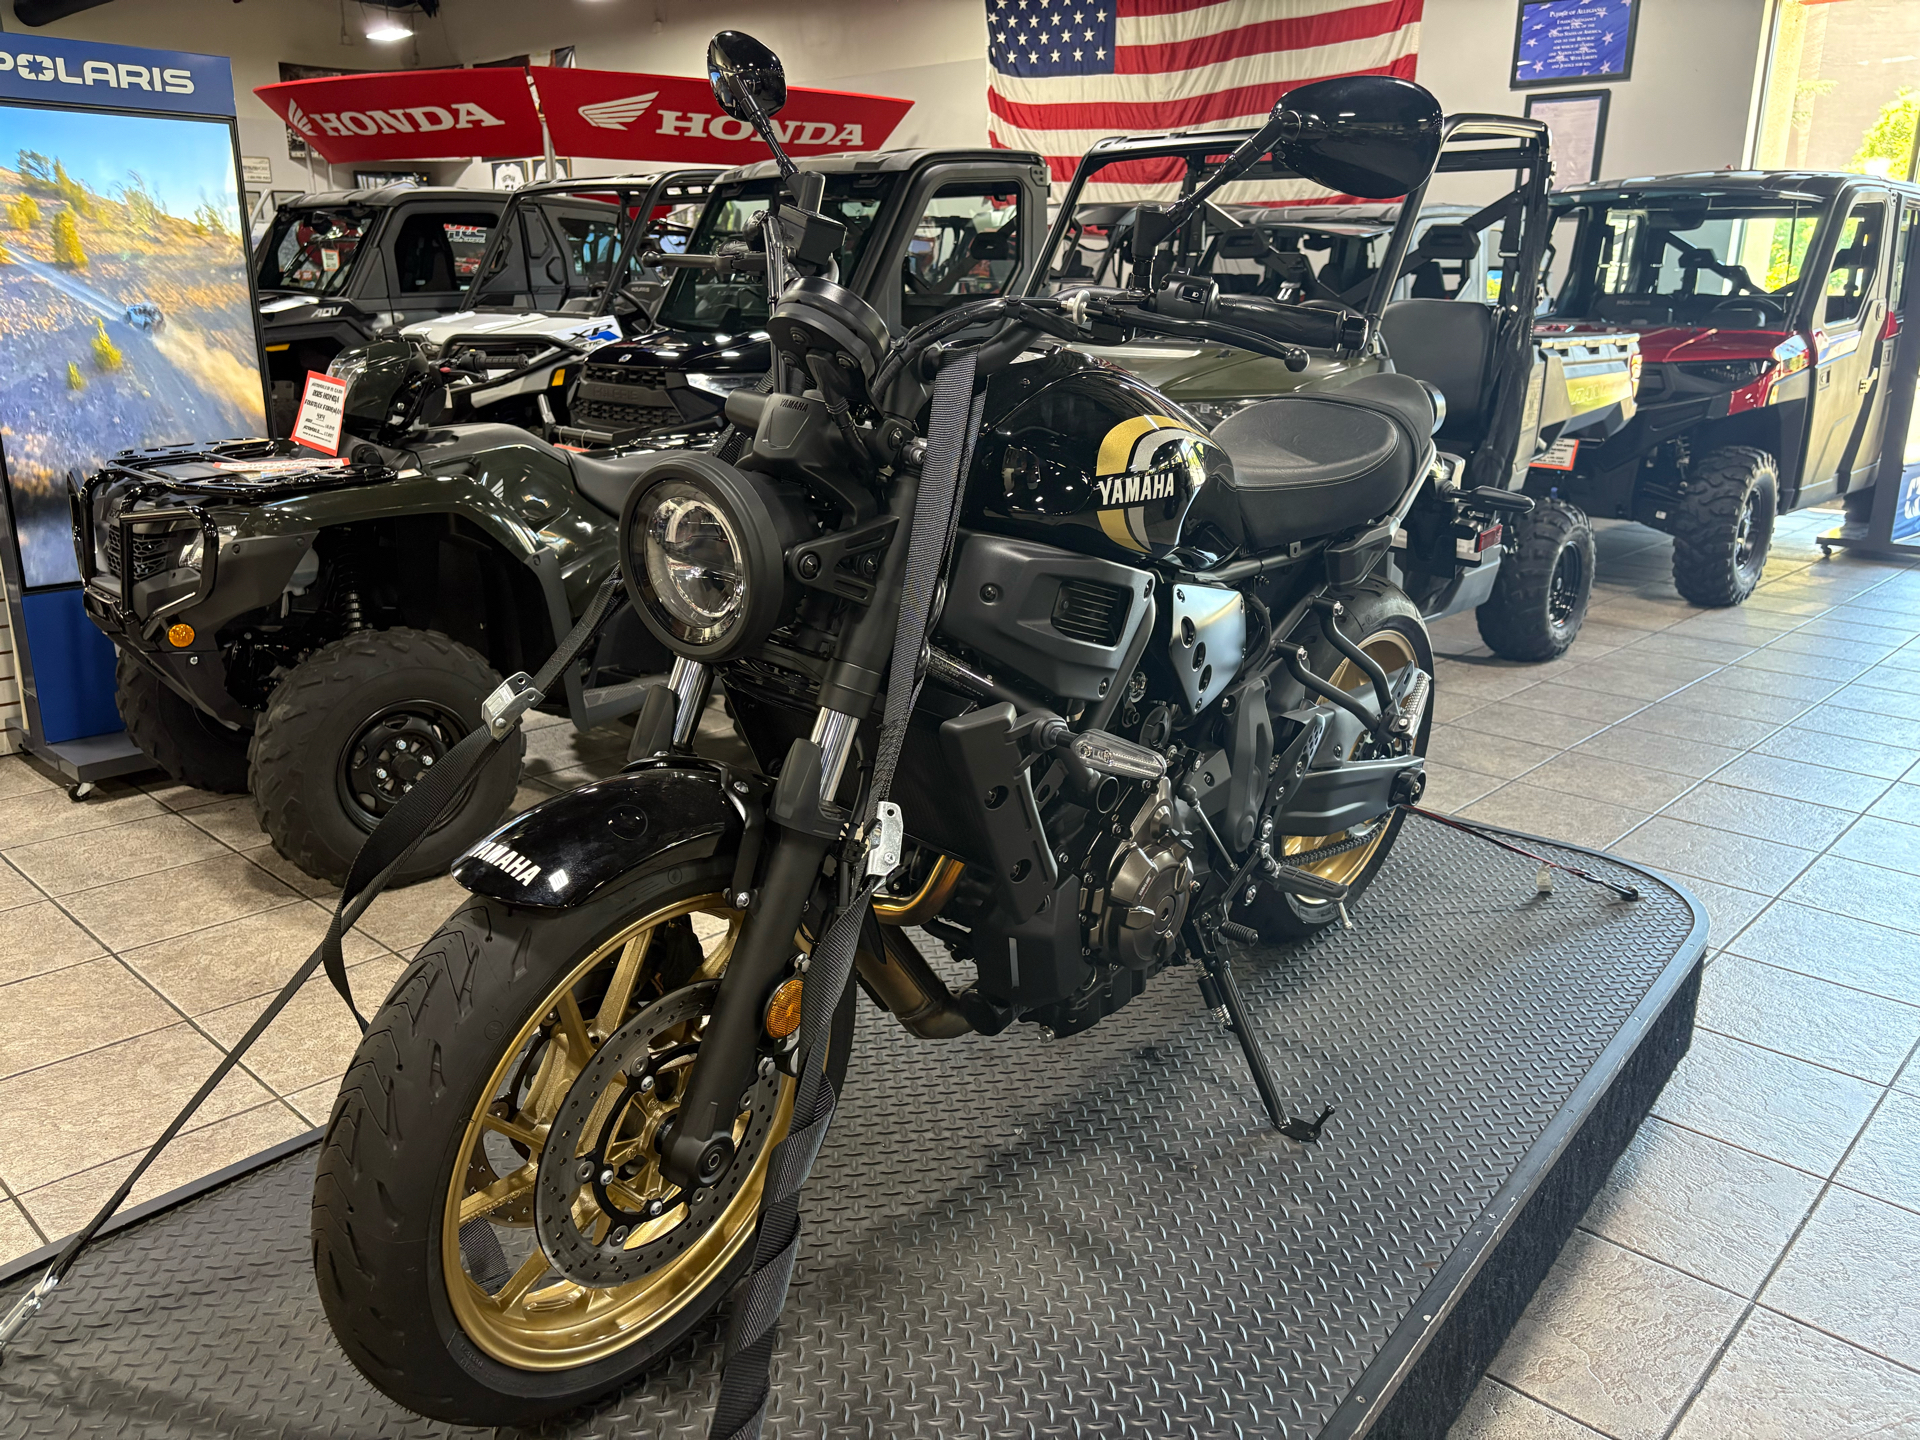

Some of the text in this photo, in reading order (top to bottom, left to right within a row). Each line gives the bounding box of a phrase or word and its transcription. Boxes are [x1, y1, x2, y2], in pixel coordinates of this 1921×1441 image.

[310, 102, 506, 136] HONDA
[656, 109, 864, 146] HONDA
[311, 306, 343, 318] ADV
[568, 324, 613, 343] XP
[780, 398, 809, 412] YAMAHA
[1100, 472, 1175, 506] YAMAHA
[469, 841, 542, 887] YAMAHA
